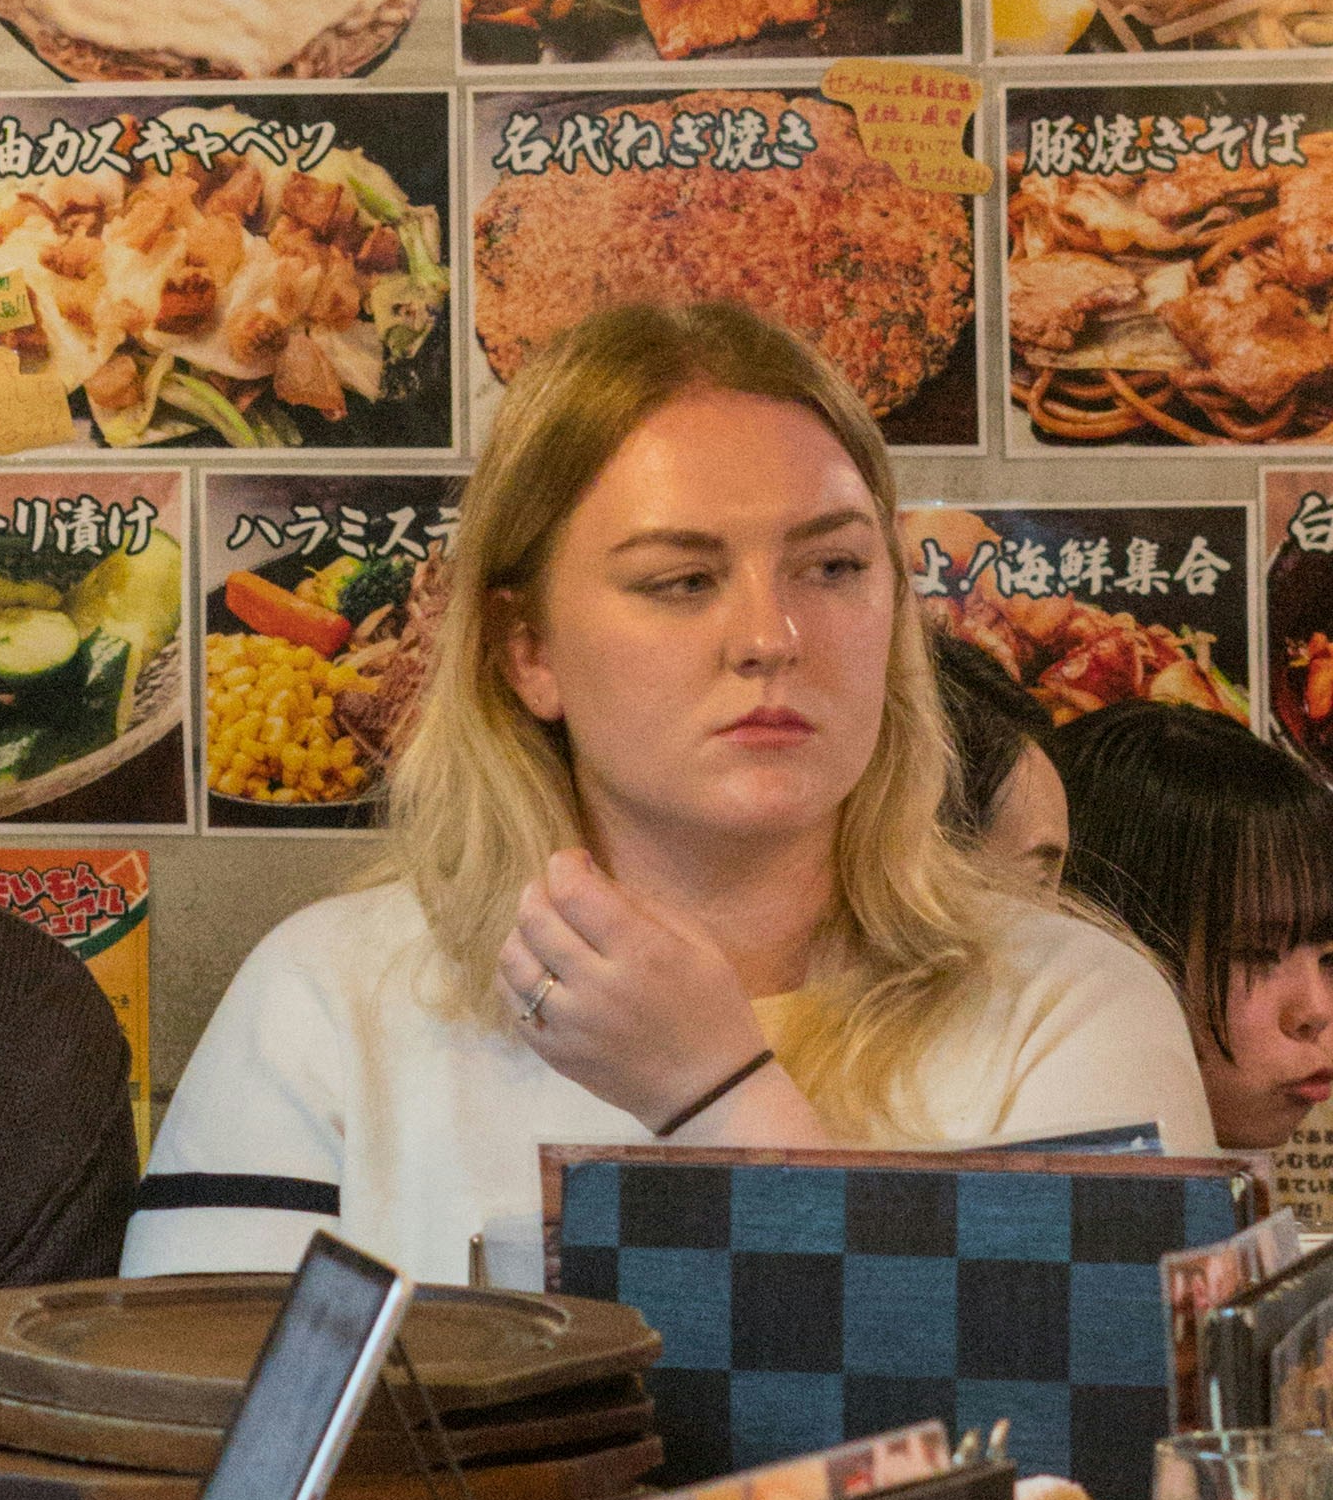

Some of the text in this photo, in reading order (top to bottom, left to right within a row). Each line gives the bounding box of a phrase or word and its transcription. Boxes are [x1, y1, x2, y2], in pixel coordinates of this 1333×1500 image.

[493, 109, 817, 174] 名代ねぎ焼き
[1026, 115, 1309, 177] 豚焼きそば
